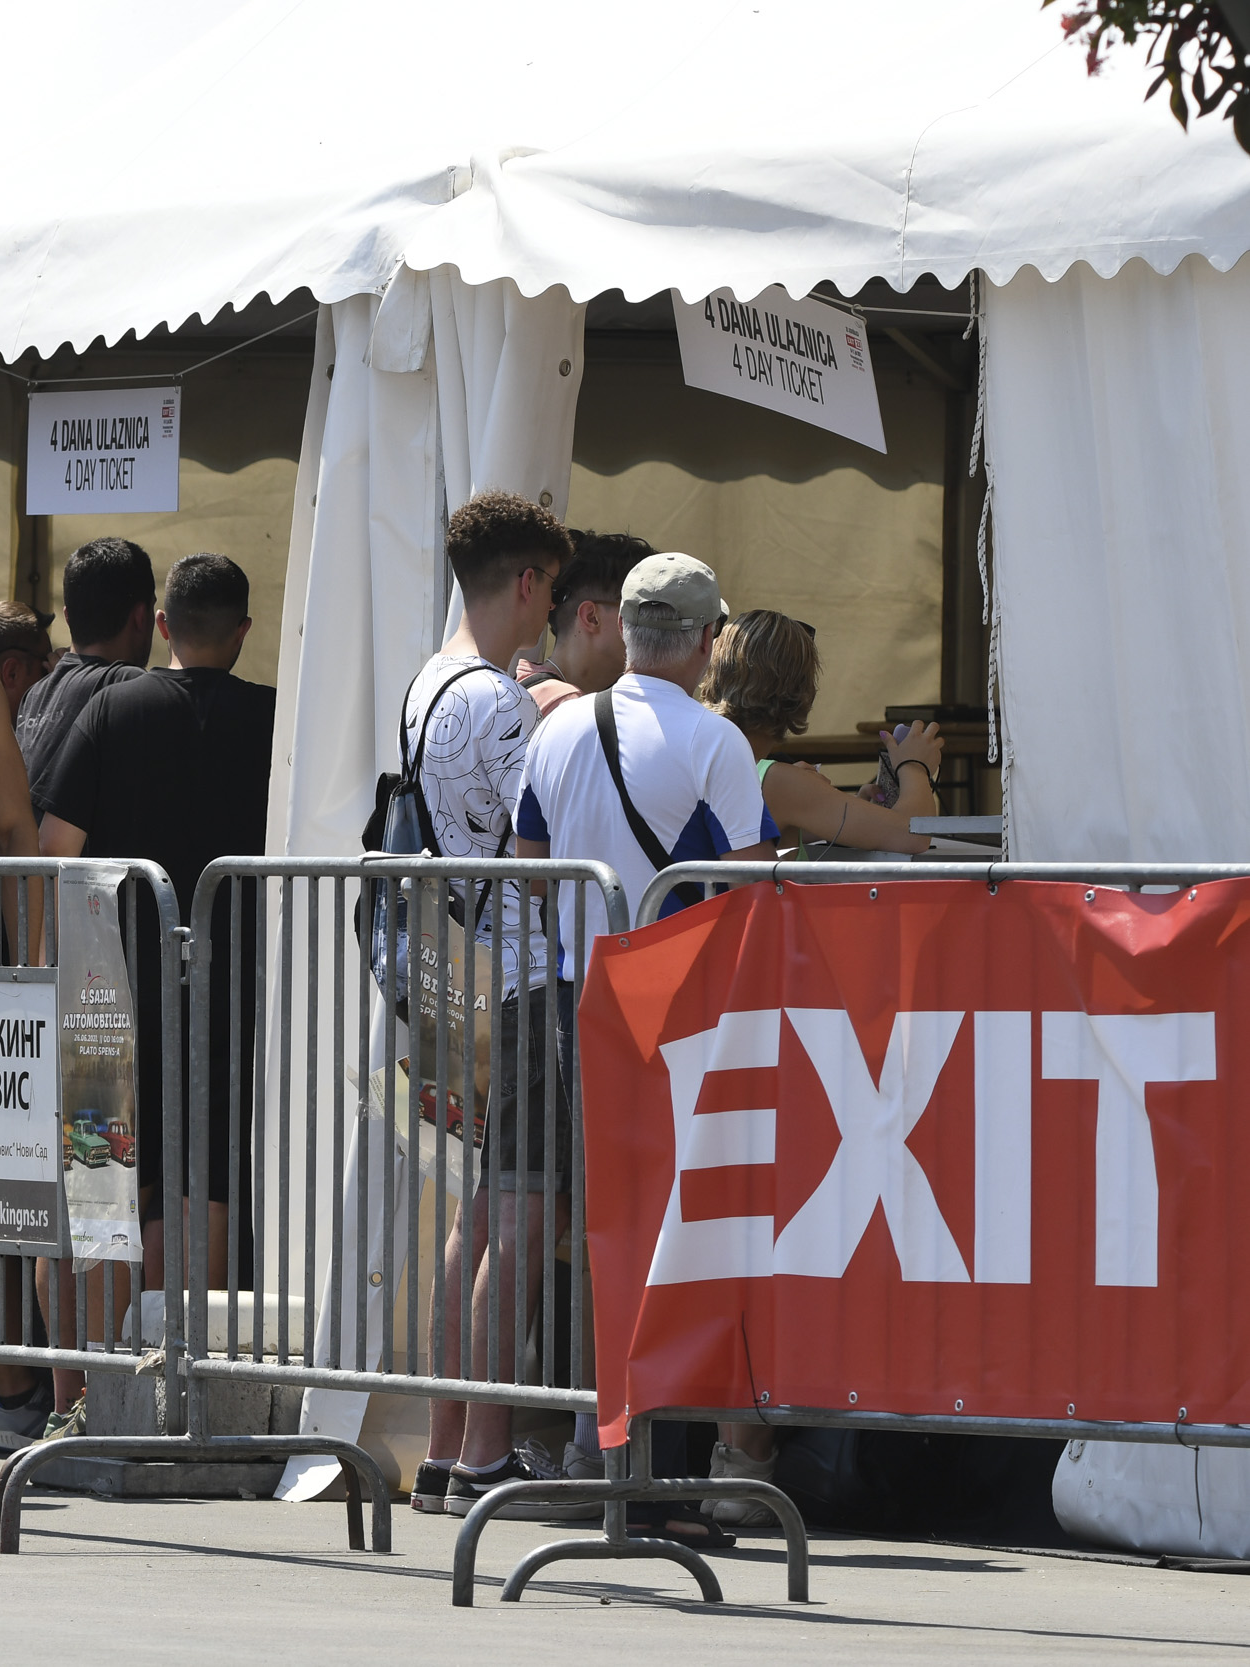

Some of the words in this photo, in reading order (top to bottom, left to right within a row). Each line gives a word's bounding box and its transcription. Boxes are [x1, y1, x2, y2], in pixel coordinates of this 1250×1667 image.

[705, 295, 715, 328] 4
[717, 297, 764, 343] DANA
[765, 312, 838, 370] ULAZNICA
[733, 343, 742, 376] 4
[745, 345, 773, 387] DAY
[776, 355, 824, 405] TICKET
[50, 420, 57, 452] 4
[61, 419, 93, 451] DANA
[97, 416, 149, 450] ULAZNICA
[65, 460, 71, 491] 4
[75, 459, 97, 491] DAY
[99, 457, 135, 490] TICKET
[89, 988, 116, 1005] SAJAM
[79, 1046, 97, 1055] PLATO
[98, 1046, 120, 1056] SPENS-A
[16, 1142, 34, 1158] Нови
[34, 1143, 48, 1161] Сад
[646, 1007, 1217, 1288] EXIT
